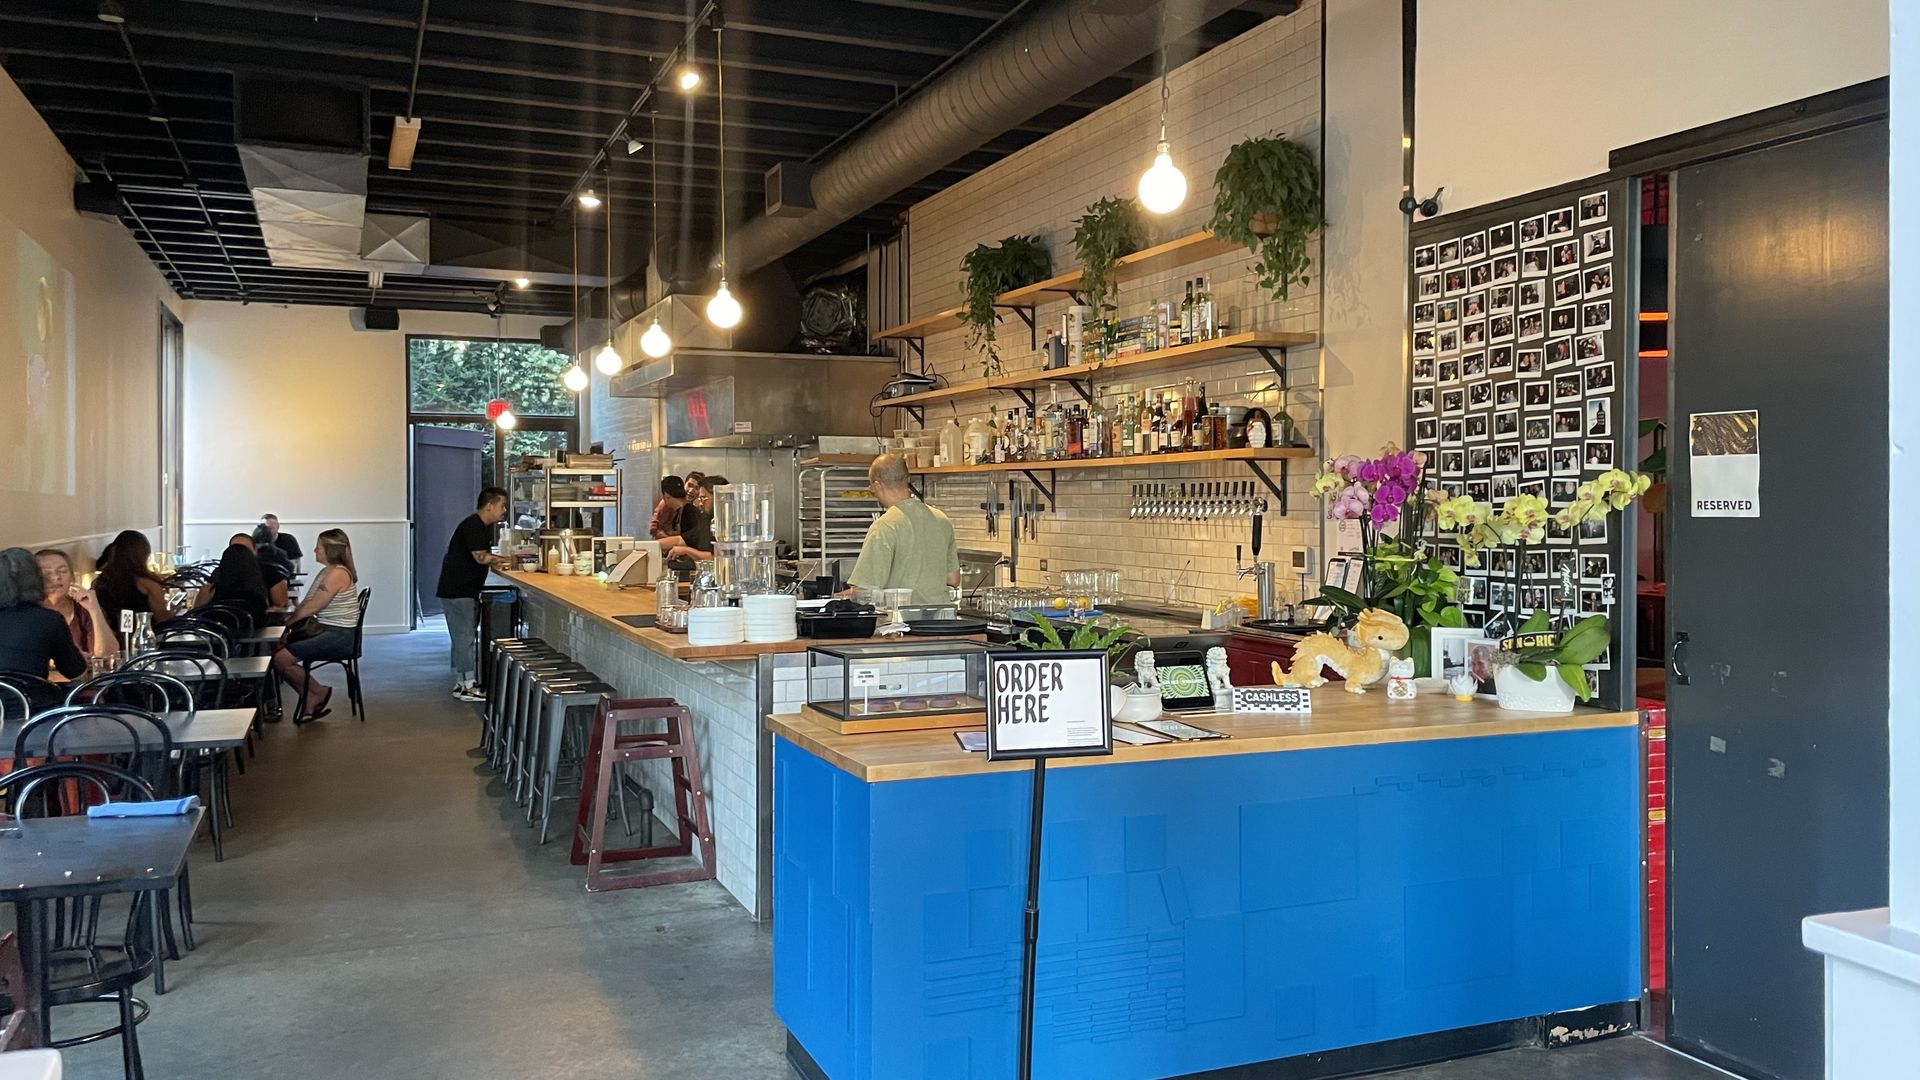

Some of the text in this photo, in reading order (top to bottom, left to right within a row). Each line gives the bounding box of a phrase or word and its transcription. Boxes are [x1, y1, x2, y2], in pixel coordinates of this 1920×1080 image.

[1696, 500, 1752, 511] RESERVED
[1536, 634, 1557, 648] RIC
[996, 662, 1063, 693] ORDER
[1245, 692, 1299, 702] CASHLESS
[997, 694, 1050, 725] HERE
